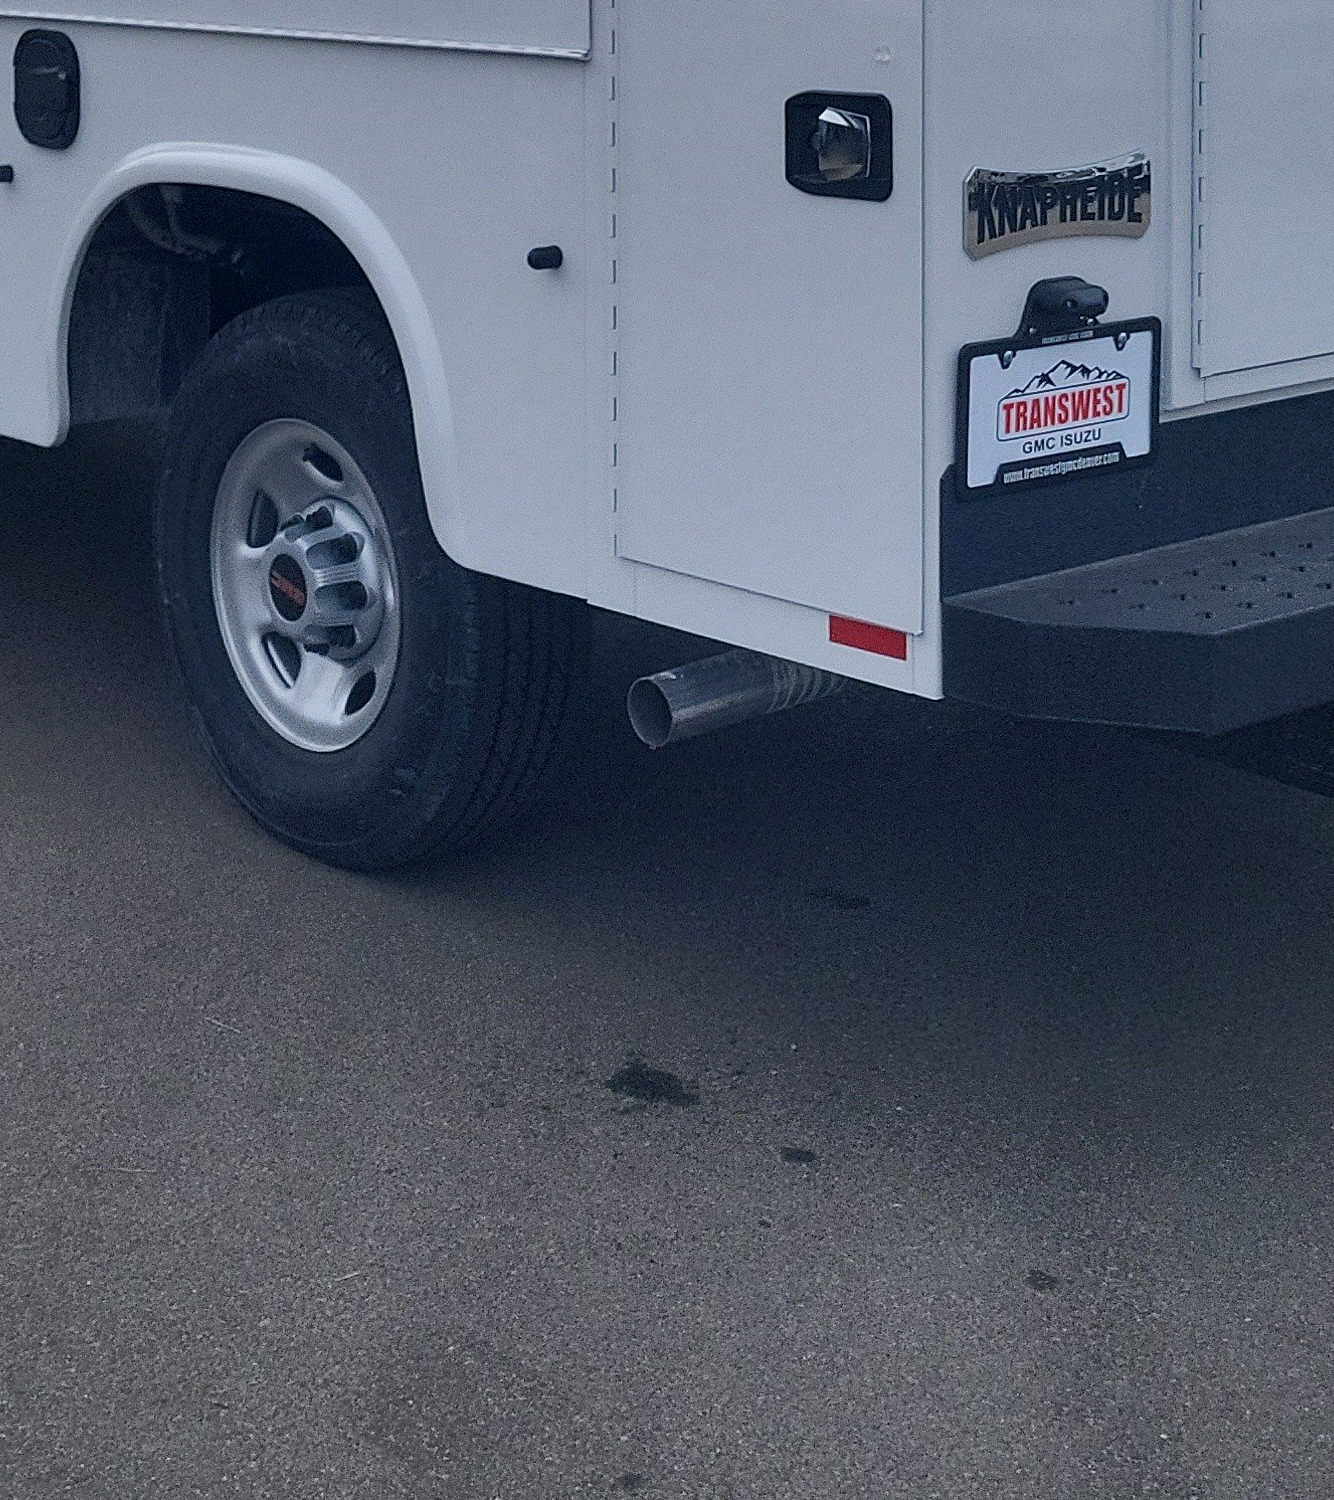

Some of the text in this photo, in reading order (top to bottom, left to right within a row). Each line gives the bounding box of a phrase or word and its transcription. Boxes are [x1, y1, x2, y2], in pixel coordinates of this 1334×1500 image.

[973, 168, 1145, 245] KNAPHEIDE
[1002, 382, 1127, 434] TRANSWEST
[1022, 427, 1102, 454] GMC ISUZU
